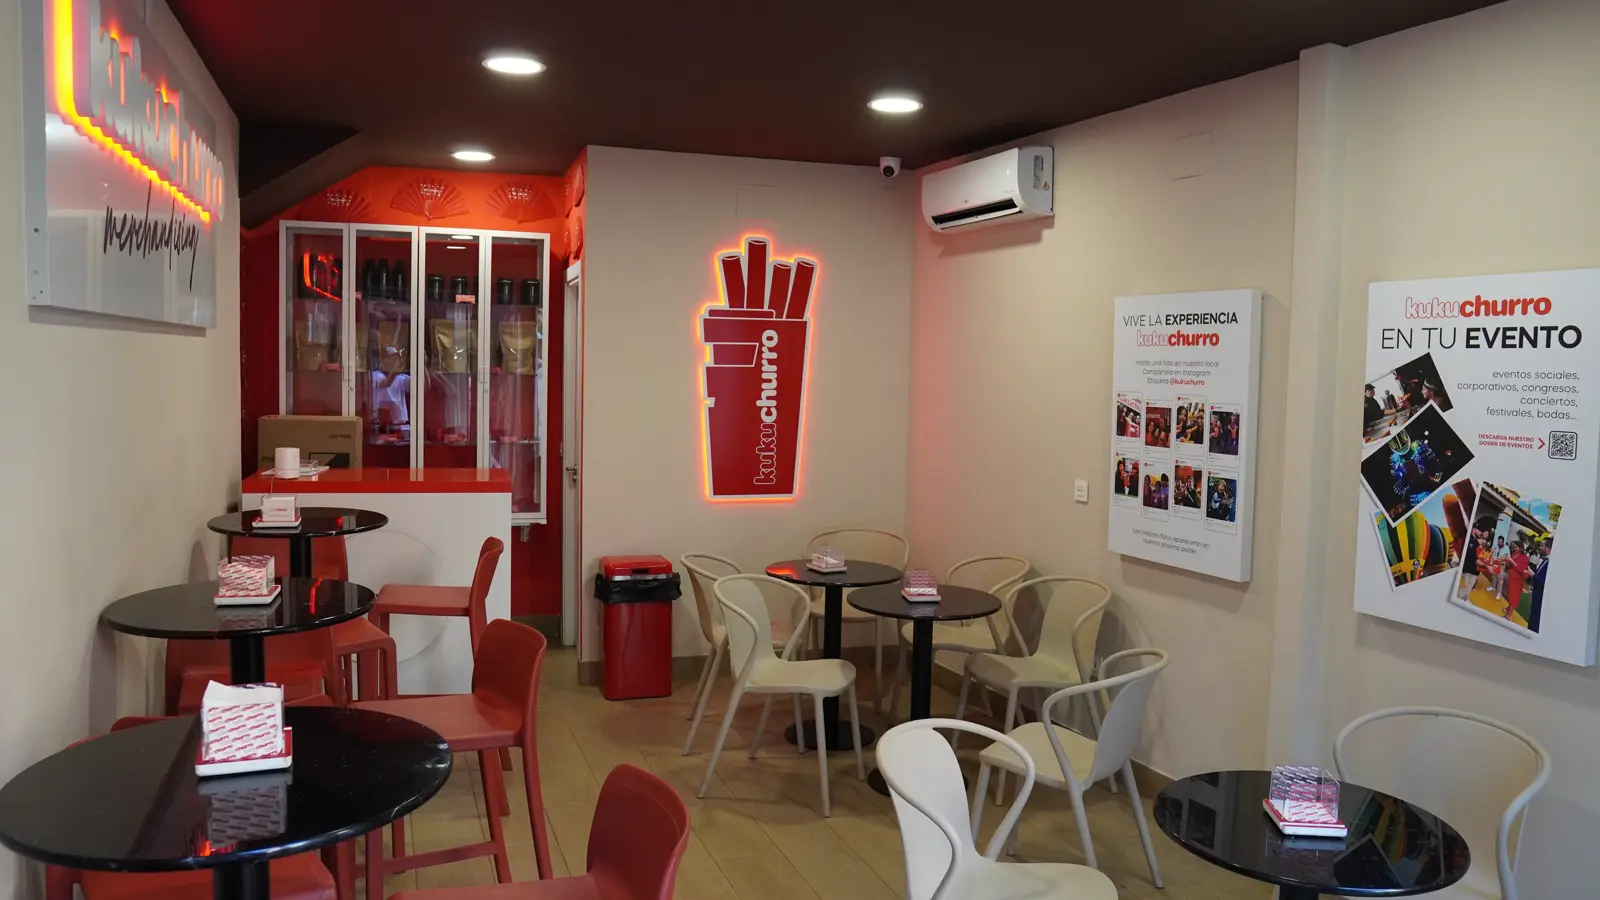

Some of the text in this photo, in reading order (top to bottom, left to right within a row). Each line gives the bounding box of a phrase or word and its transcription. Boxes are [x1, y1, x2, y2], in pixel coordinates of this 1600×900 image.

[103, 179, 199, 292] merchandising
[1405, 295, 1552, 319] kukuchurro
[1123, 312, 1238, 327] VIVE LA EXPERIENCIA
[1137, 329, 1220, 347] kukuchurro
[1381, 325, 1582, 349] EN TU EVENTO
[1183, 369, 1212, 378] Instagram
[1492, 370, 1580, 381] eventos sociales,
[1457, 382, 1579, 395] corporativos, congresos,
[753, 329, 779, 485] kukuchurro
[1520, 396, 1578, 408] conciertos,
[1486, 406, 1578, 421] festivales, bodas...
[1478, 433, 1508, 441] DESCARGA
